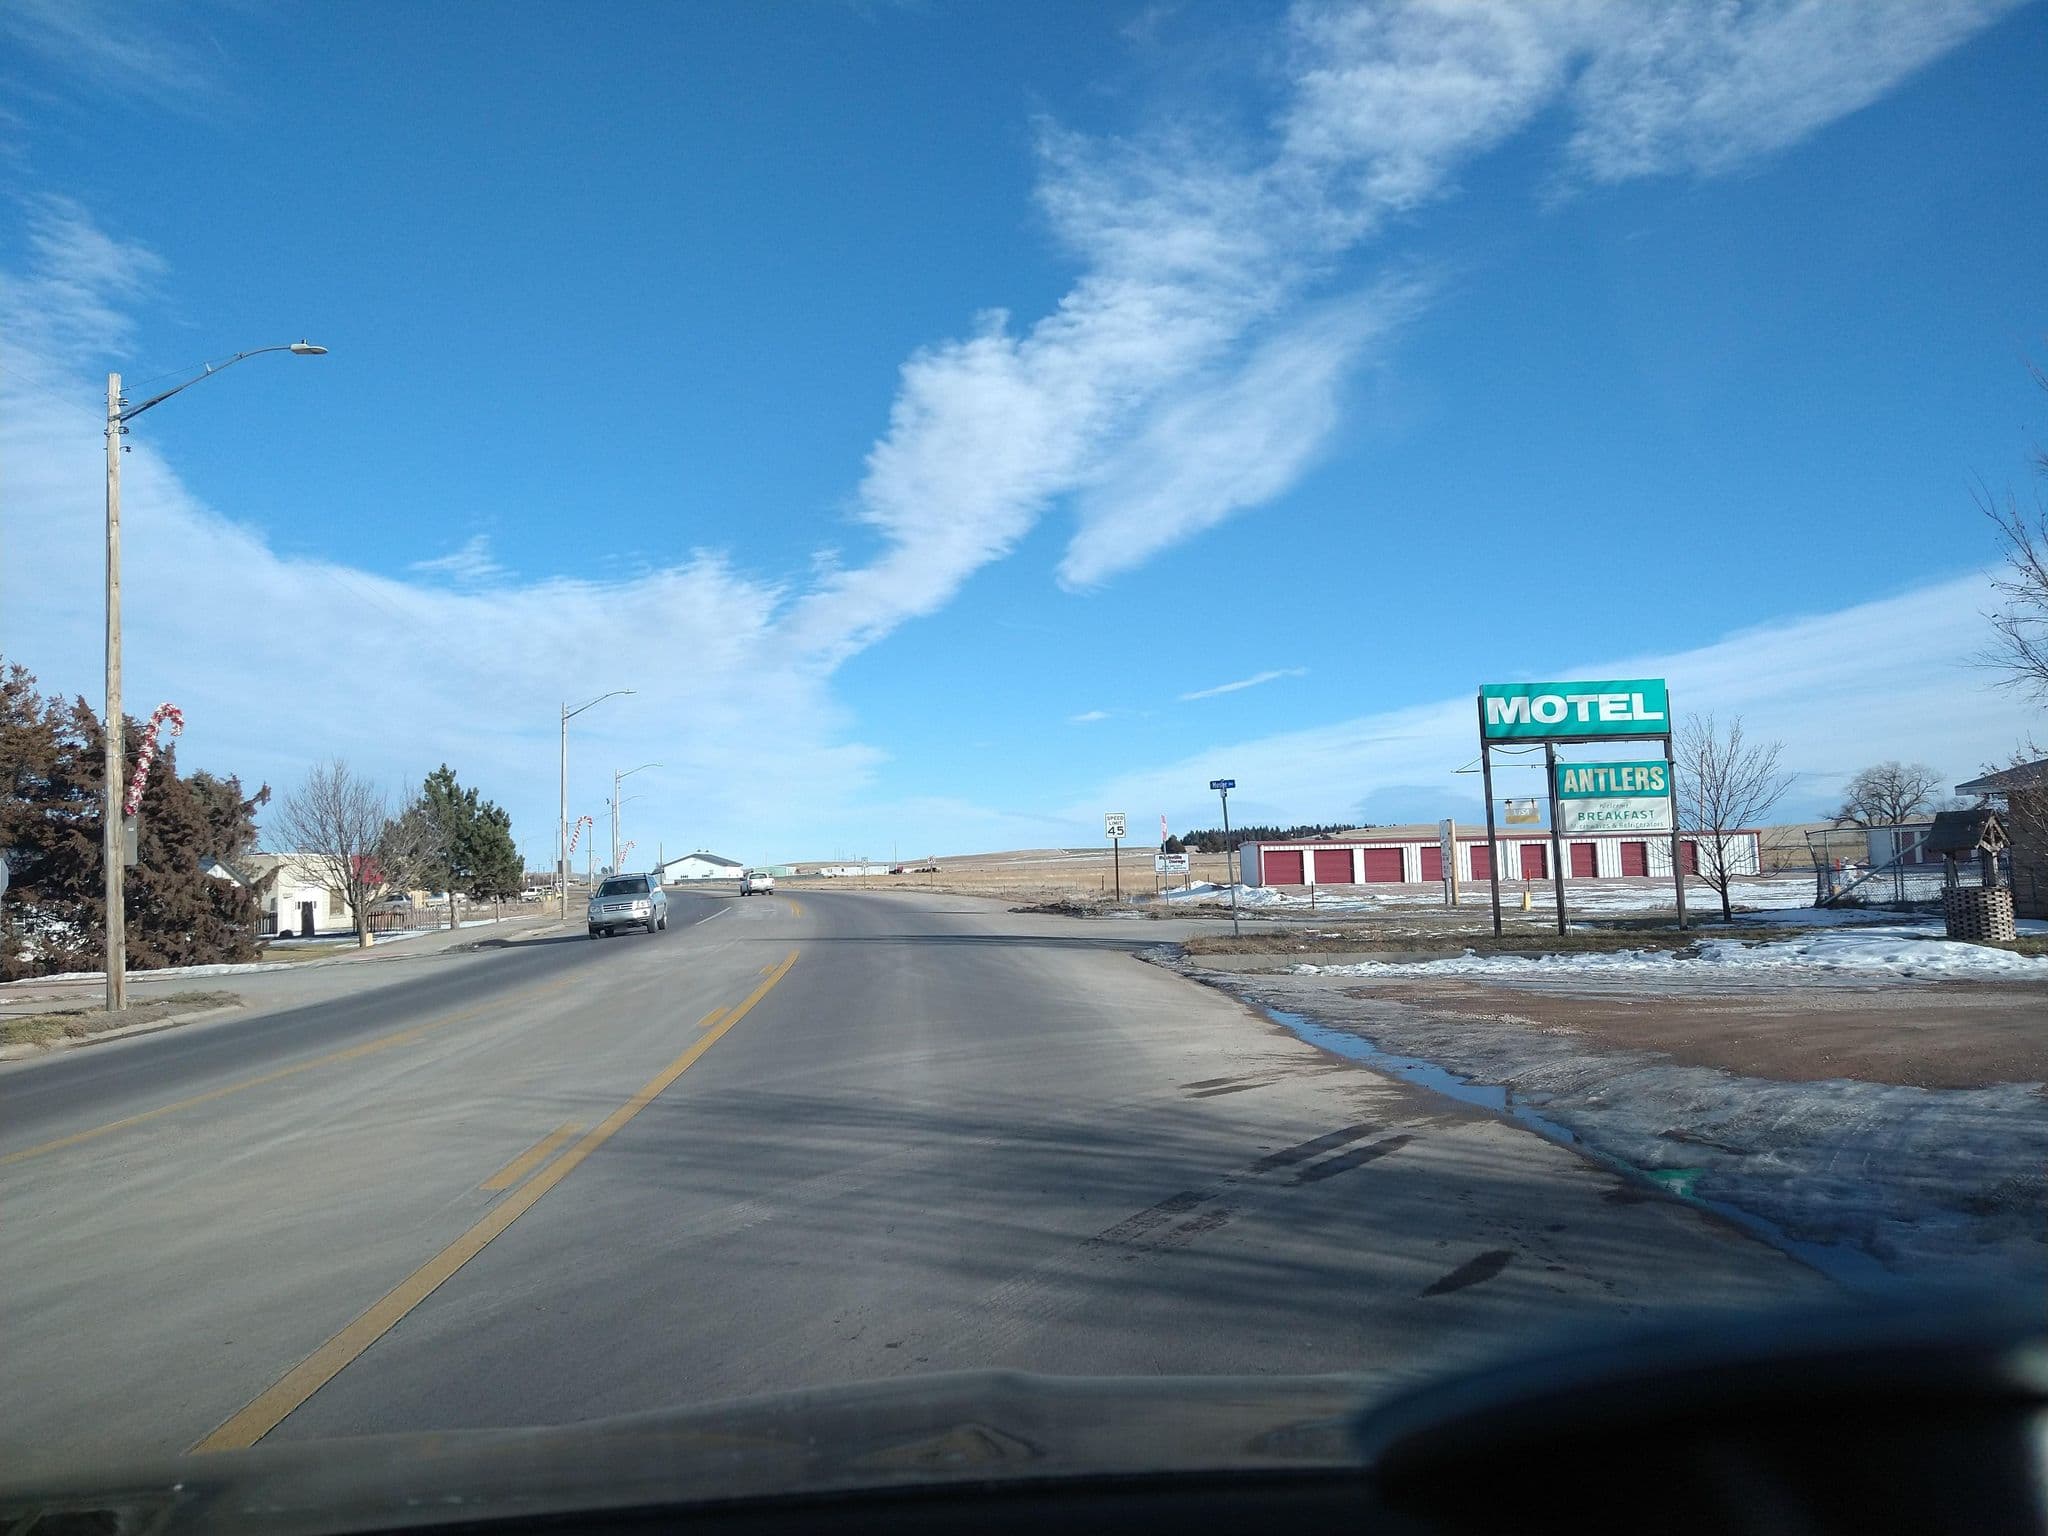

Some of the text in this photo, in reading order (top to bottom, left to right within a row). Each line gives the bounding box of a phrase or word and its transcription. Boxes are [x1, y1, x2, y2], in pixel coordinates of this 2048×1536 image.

[1486, 692, 1664, 725] MOTEL
[1564, 766, 1665, 793] ANTLERS
[1578, 810, 1655, 821] BREAKFAST
[1108, 826, 1124, 835] 45
